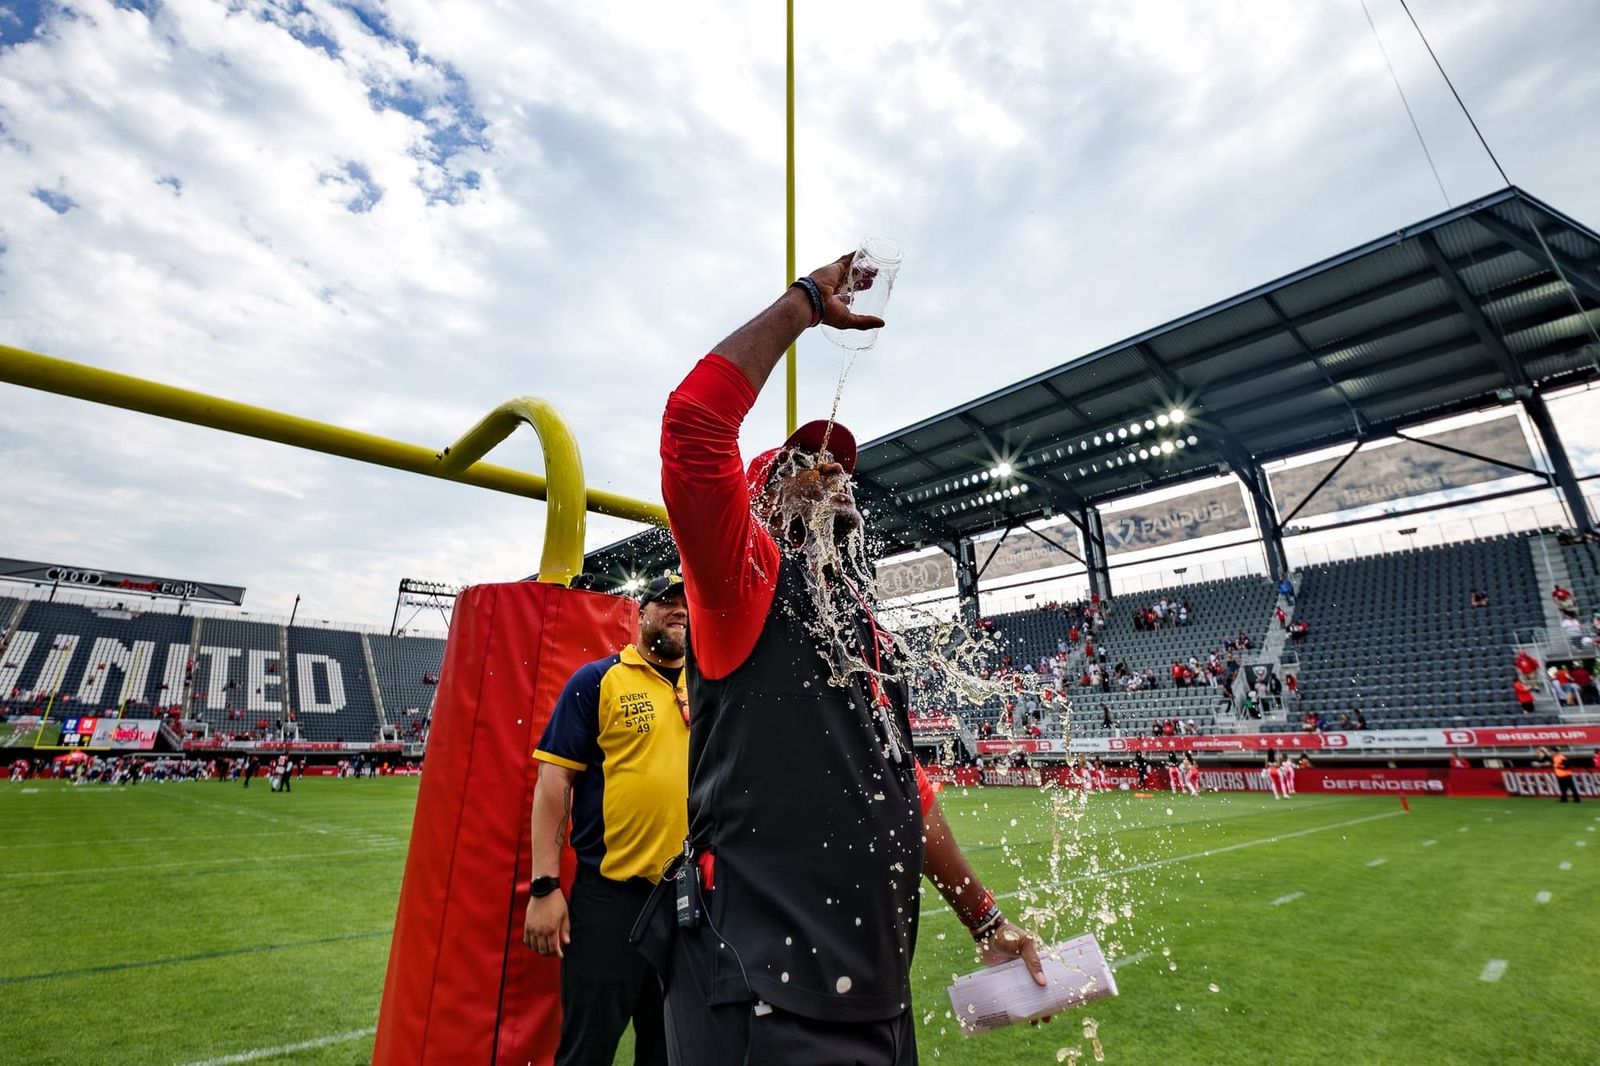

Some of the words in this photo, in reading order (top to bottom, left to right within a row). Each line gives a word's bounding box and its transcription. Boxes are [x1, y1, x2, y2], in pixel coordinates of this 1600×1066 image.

[1140, 500, 1238, 539] FANDUEL
[620, 692, 648, 703] EVENT
[621, 701, 654, 717] 7325
[625, 713, 656, 728] STAFF
[637, 722, 651, 733] 49
[1322, 779, 1444, 791] DEFENDERS
[1501, 771, 1600, 796] DEFENERS
